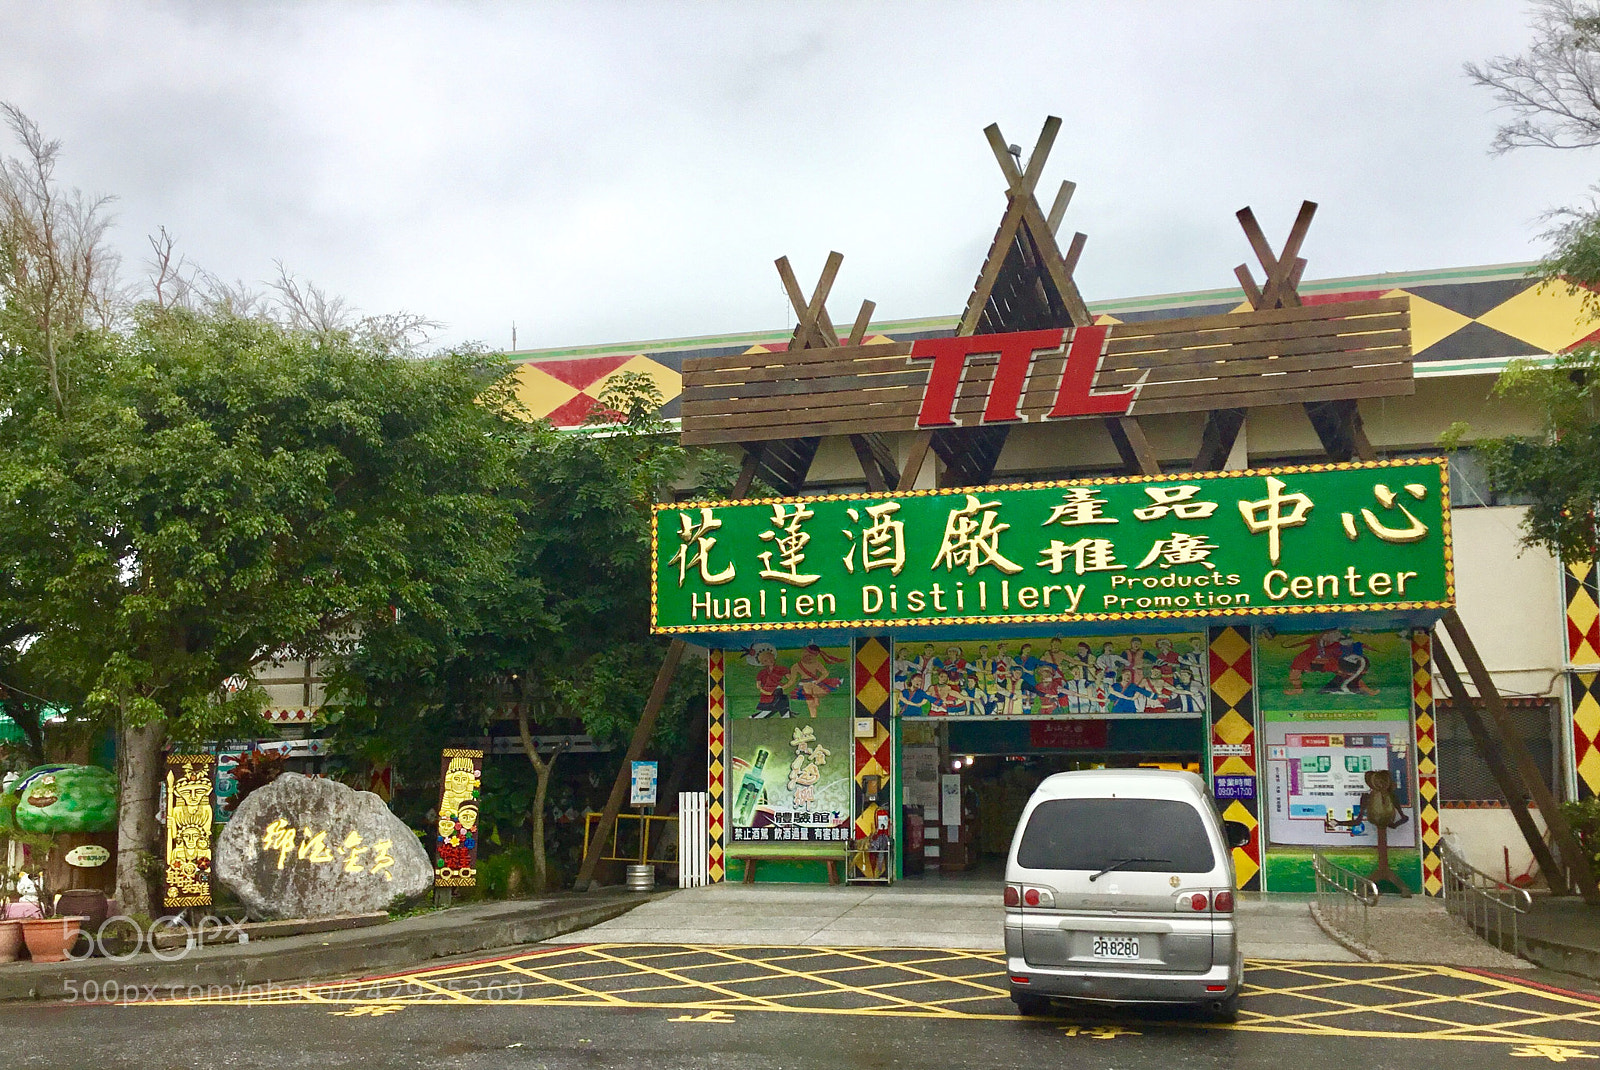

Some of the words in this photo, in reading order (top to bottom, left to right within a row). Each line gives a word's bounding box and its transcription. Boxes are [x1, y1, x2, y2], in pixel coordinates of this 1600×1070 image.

[907, 325, 1151, 428] TTL
[1042, 484, 1219, 527] 產品
[1238, 476, 1428, 567] 中心
[668, 494, 1024, 588] 花蓮酒廠
[1036, 532, 1219, 576] 推廣
[691, 589, 836, 621] Hualien
[862, 580, 1086, 615] Distillery
[1103, 591, 1250, 610] Promotion
[1111, 571, 1241, 589] Products
[1263, 566, 1418, 600] Center
[734, 828, 769, 840] 禁止酒駕
[774, 828, 809, 840] 飲酒過量
[814, 828, 849, 840] 有害健康
[775, 812, 830, 824] 體驗館
